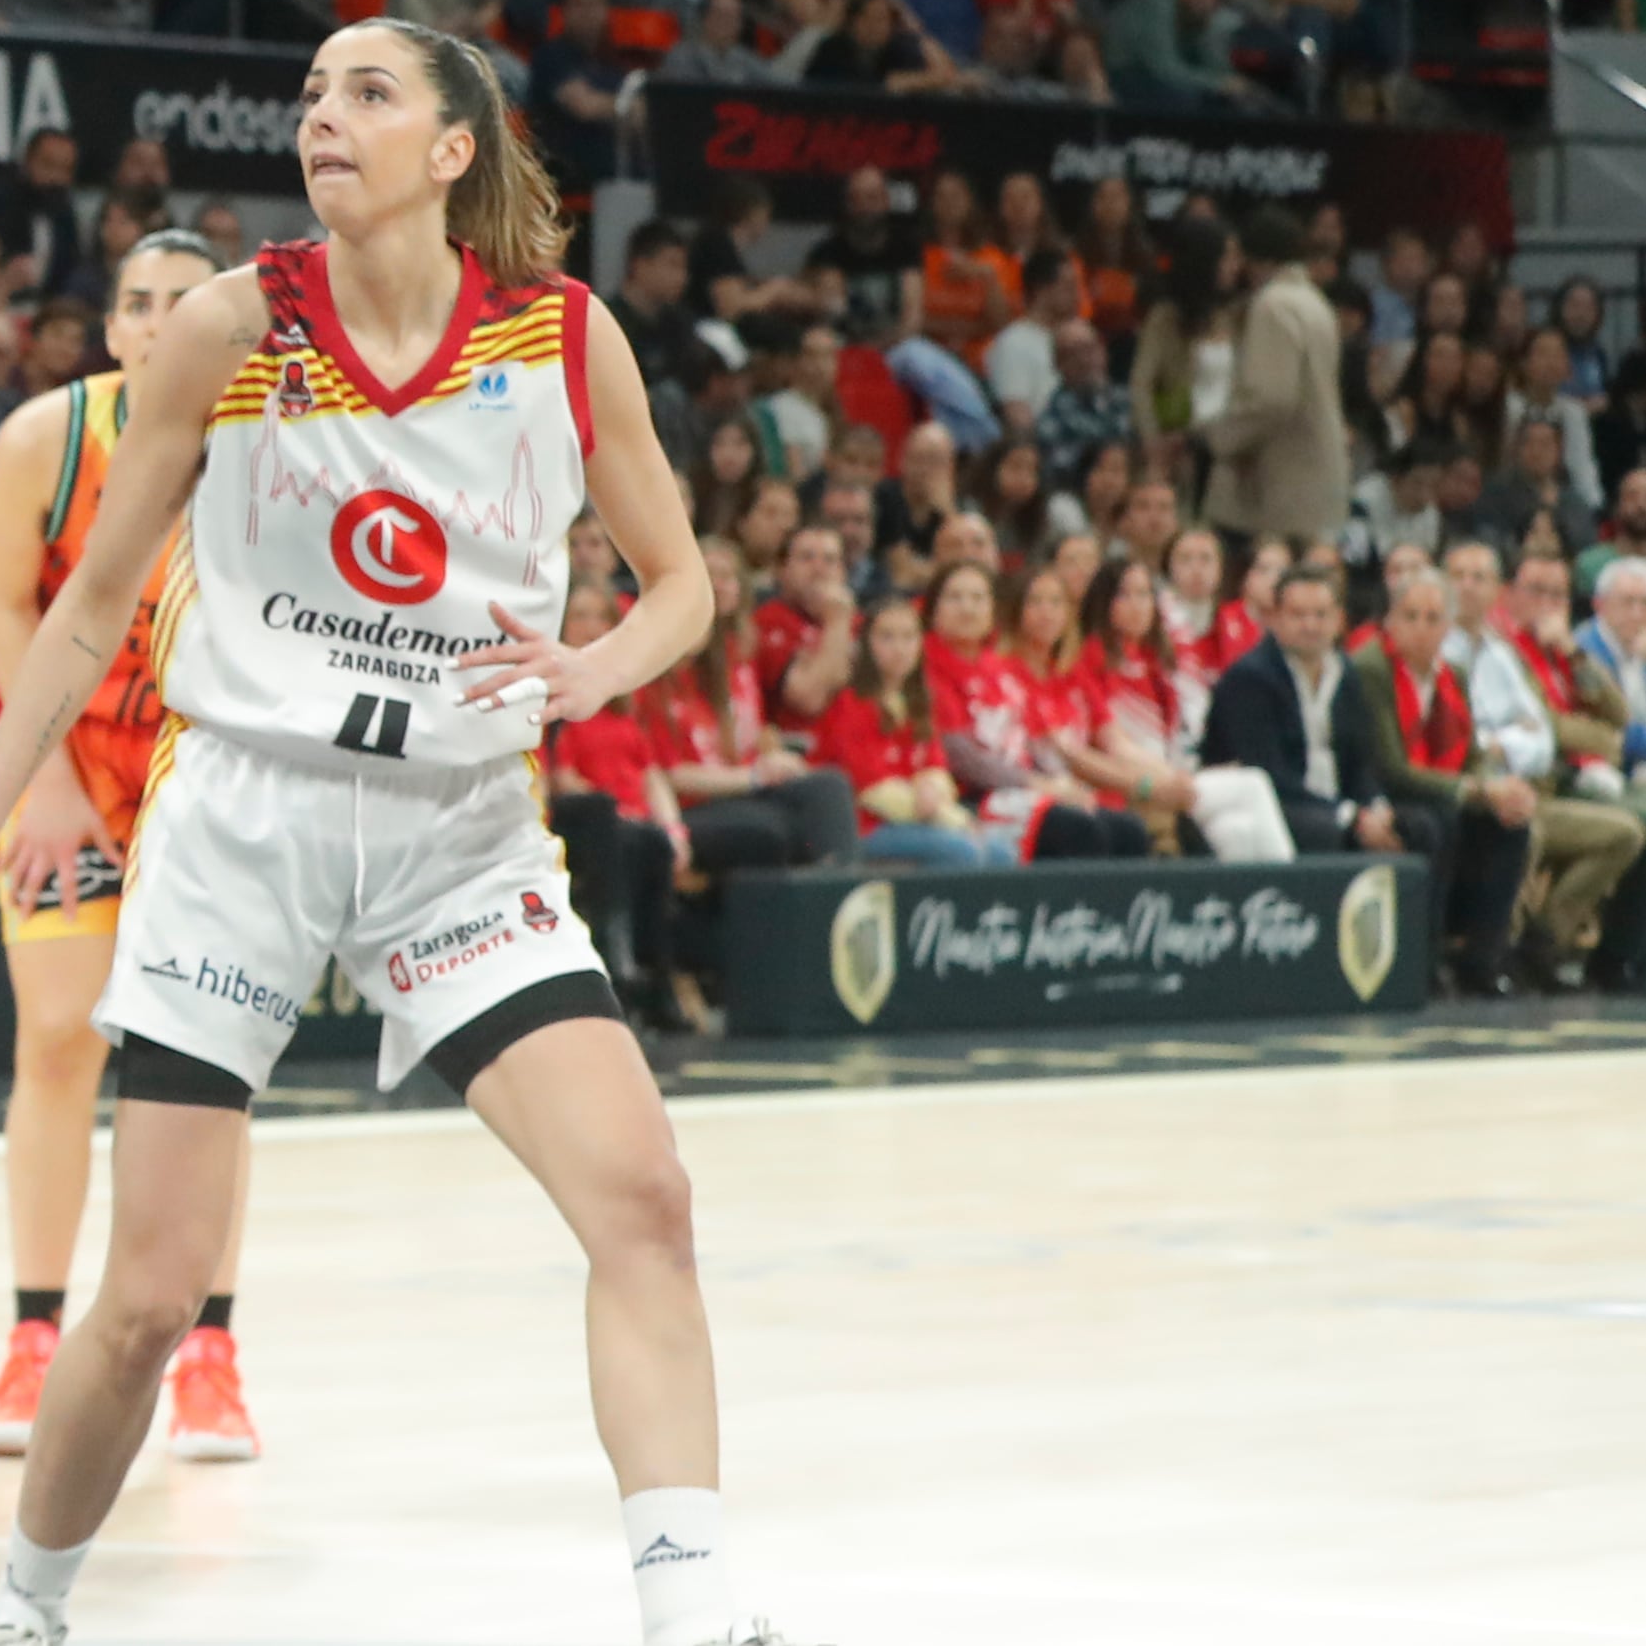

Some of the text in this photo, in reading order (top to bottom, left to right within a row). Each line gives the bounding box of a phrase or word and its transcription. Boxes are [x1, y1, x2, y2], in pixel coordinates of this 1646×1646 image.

[326, 649, 441, 685] ZARAGOZA
[411, 912, 505, 959] Zaragoza
[196, 958, 304, 1027] hiberus
